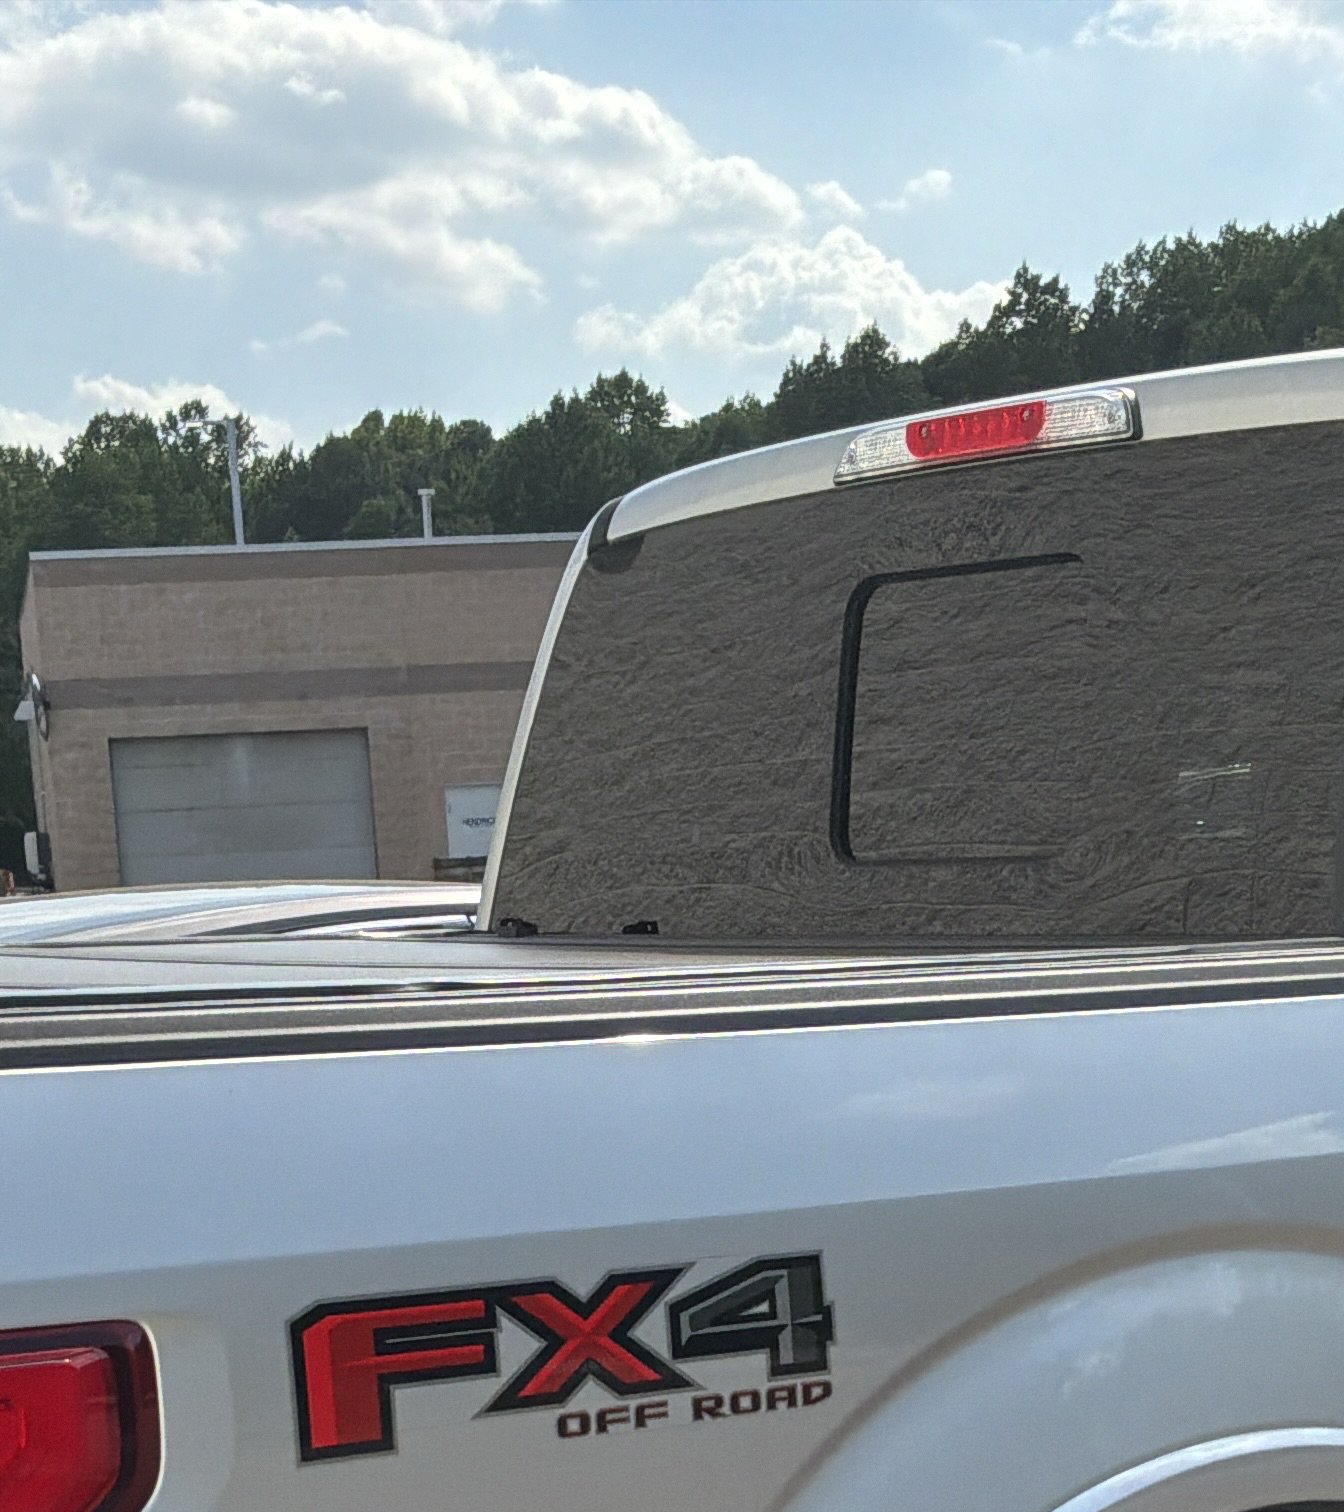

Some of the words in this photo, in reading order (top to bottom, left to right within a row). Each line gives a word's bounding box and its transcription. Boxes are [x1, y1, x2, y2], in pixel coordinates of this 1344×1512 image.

[285, 1249, 835, 1467] FX4
[557, 1399, 670, 1439] OFF
[691, 1379, 833, 1422] ROAD
